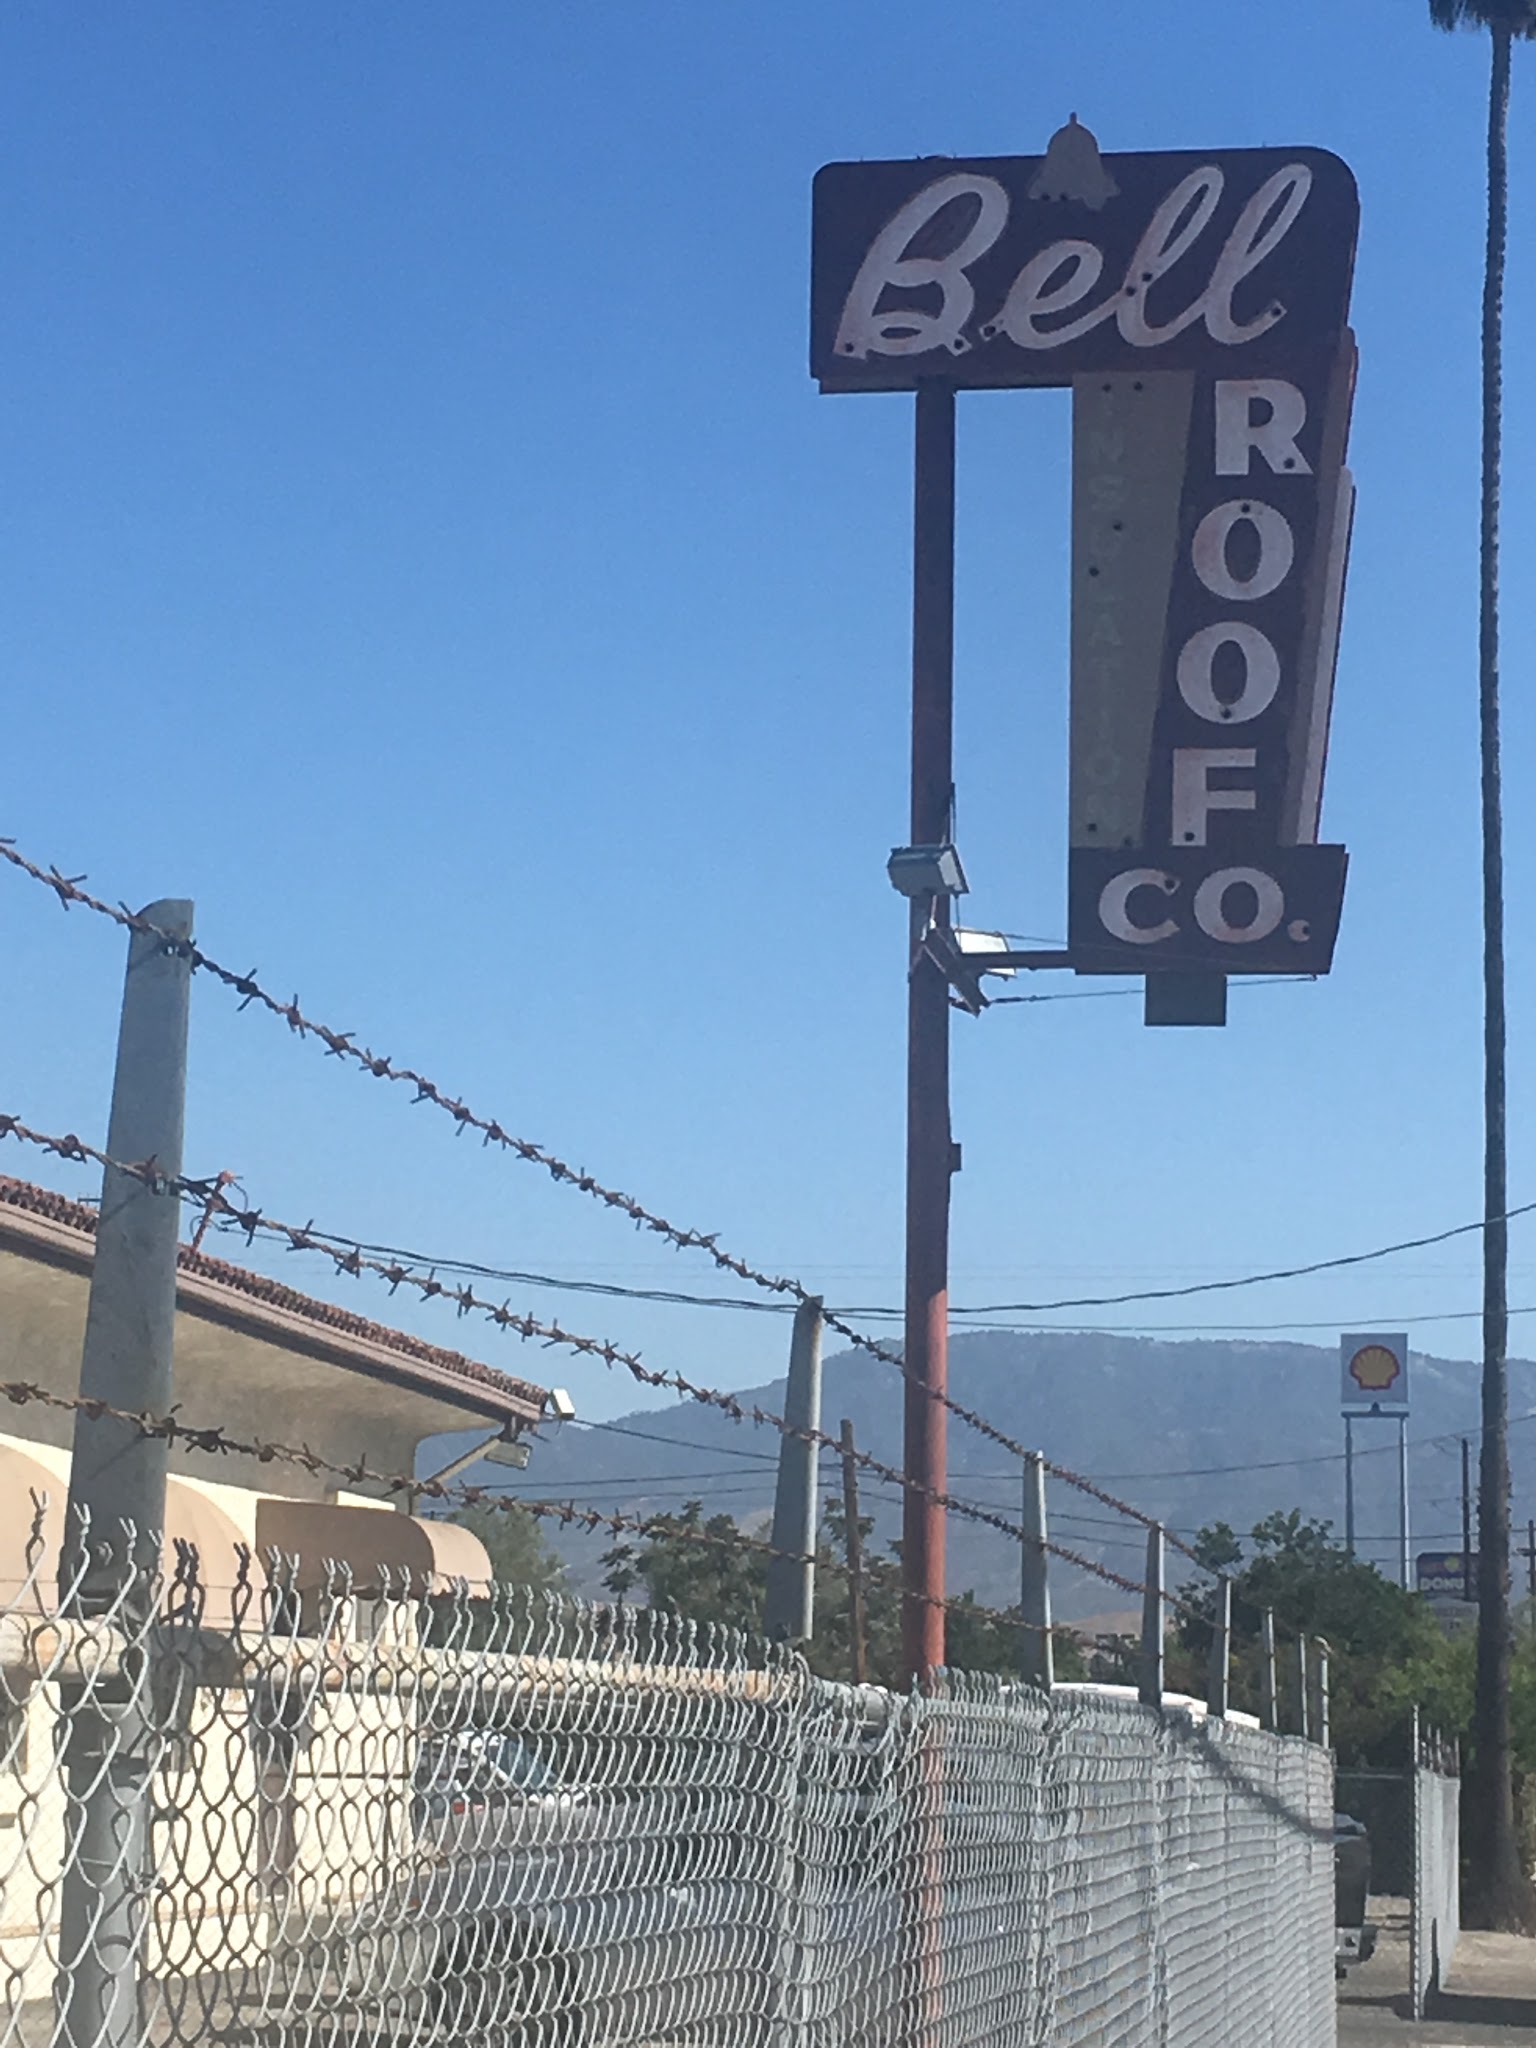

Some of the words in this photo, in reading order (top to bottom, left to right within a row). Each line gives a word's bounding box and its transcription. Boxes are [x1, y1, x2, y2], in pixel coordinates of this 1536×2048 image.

[833, 163, 1313, 360] Bell
[1172, 379, 1314, 847] ROOF
[1098, 866, 1311, 944] CO.
[1420, 1576, 1472, 1591] DONU
